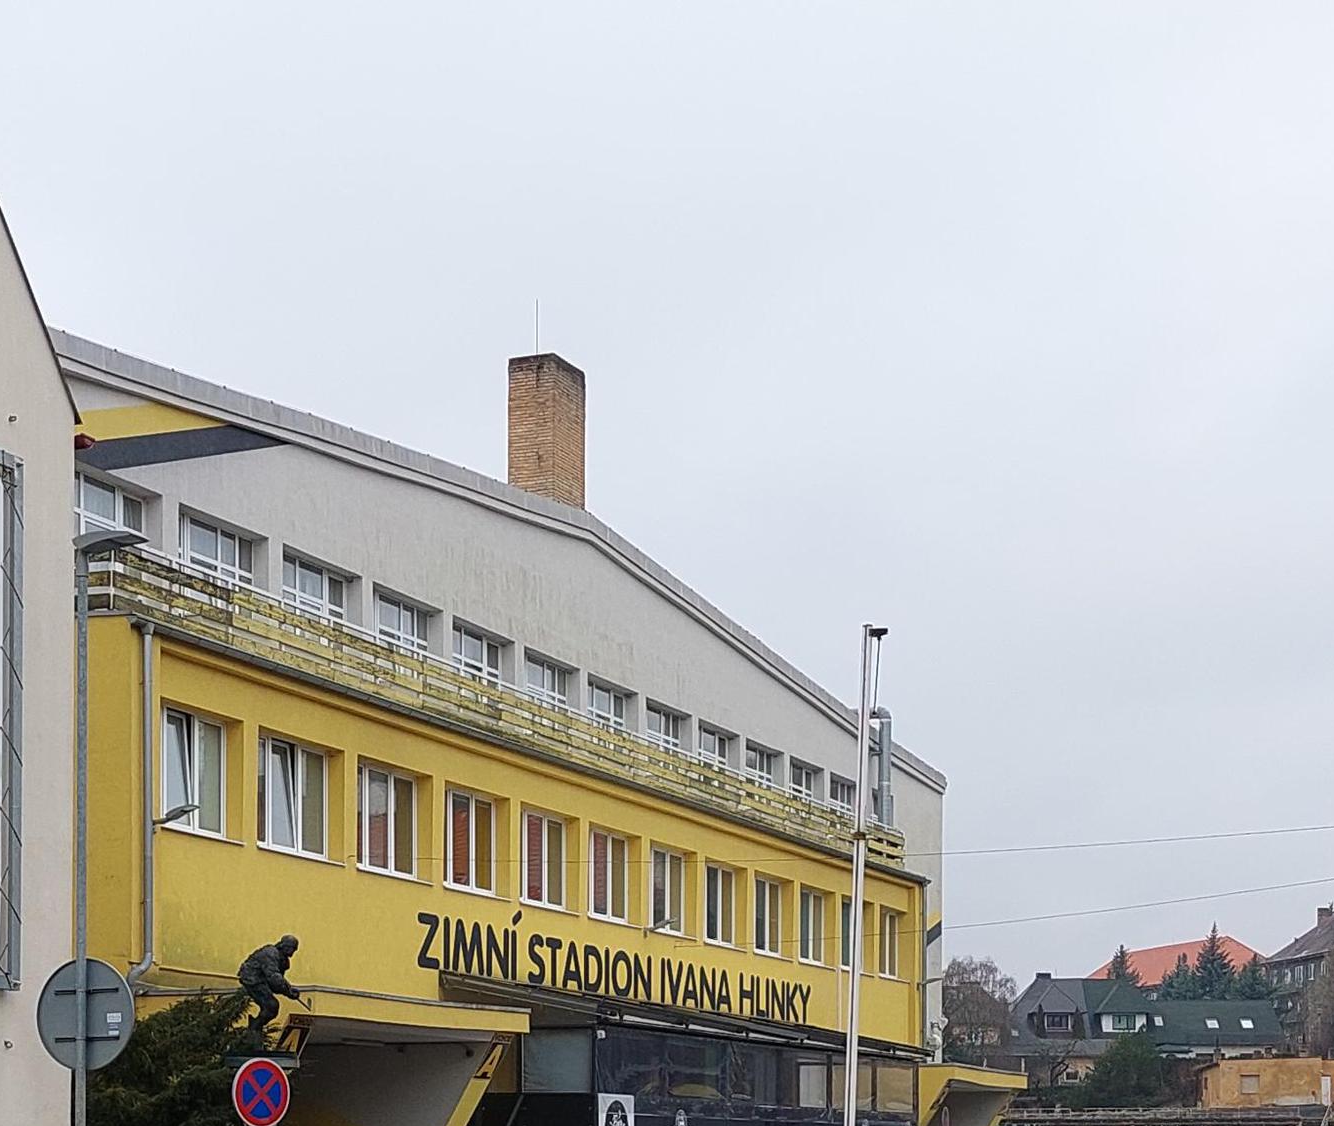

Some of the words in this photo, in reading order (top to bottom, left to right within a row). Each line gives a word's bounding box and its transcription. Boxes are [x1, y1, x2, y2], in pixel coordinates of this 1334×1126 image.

[417, 910, 523, 982] ZIMNÍ
[527, 933, 653, 1001] STADION
[660, 957, 733, 1014] IVANA
[739, 972, 811, 1024] HLINKY
